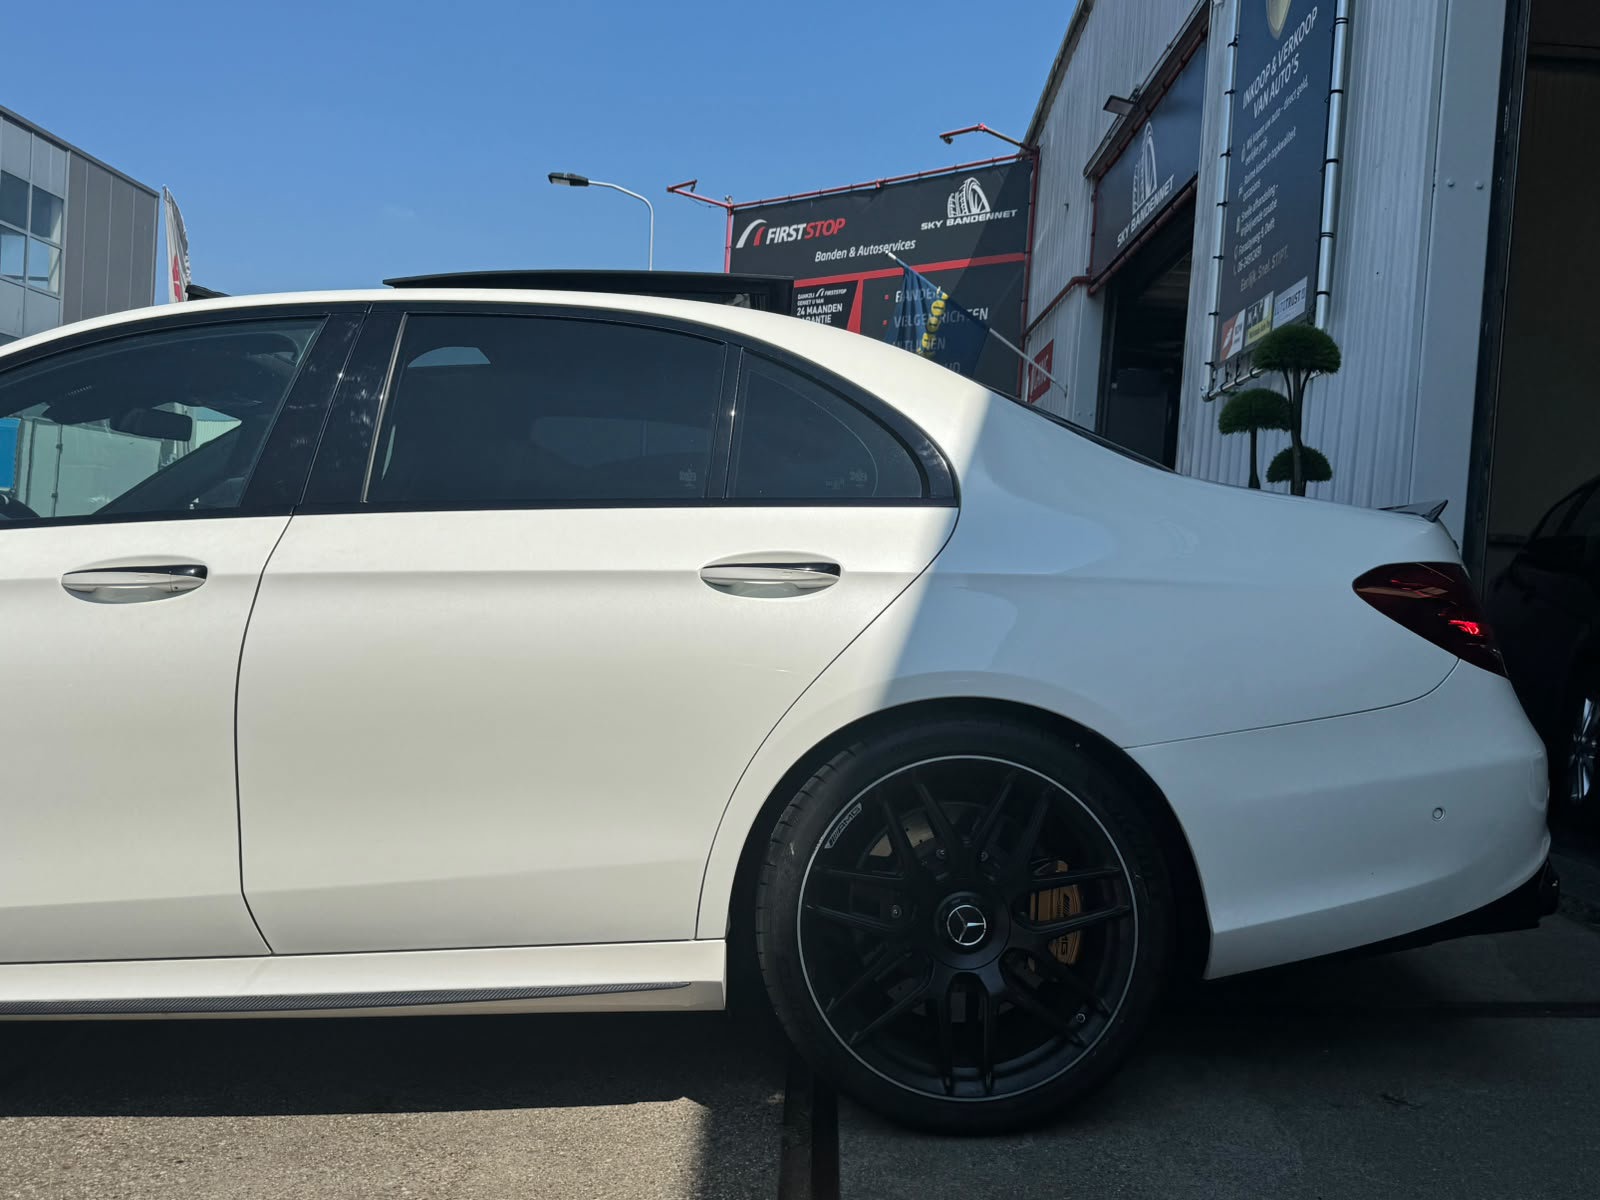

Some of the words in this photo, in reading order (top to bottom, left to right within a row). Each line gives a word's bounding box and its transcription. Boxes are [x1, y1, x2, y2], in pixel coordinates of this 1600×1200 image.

[1243, 63, 1271, 110] INKOOP
[1271, 56, 1277, 76] &
[1278, 6, 1318, 68] VERKOOP
[1253, 88, 1269, 119] VAN
[1269, 53, 1299, 103] AUTO'S
[766, 217, 846, 245] FIRSTSTOP
[921, 219, 944, 231] SKY
[946, 208, 1018, 227] BANDENNET
[815, 249, 847, 263] Banden
[848, 246, 856, 258] &
[857, 239, 917, 257] Autoservices
[797, 307, 806, 316] 24
[806, 303, 843, 316] MAANDEN
